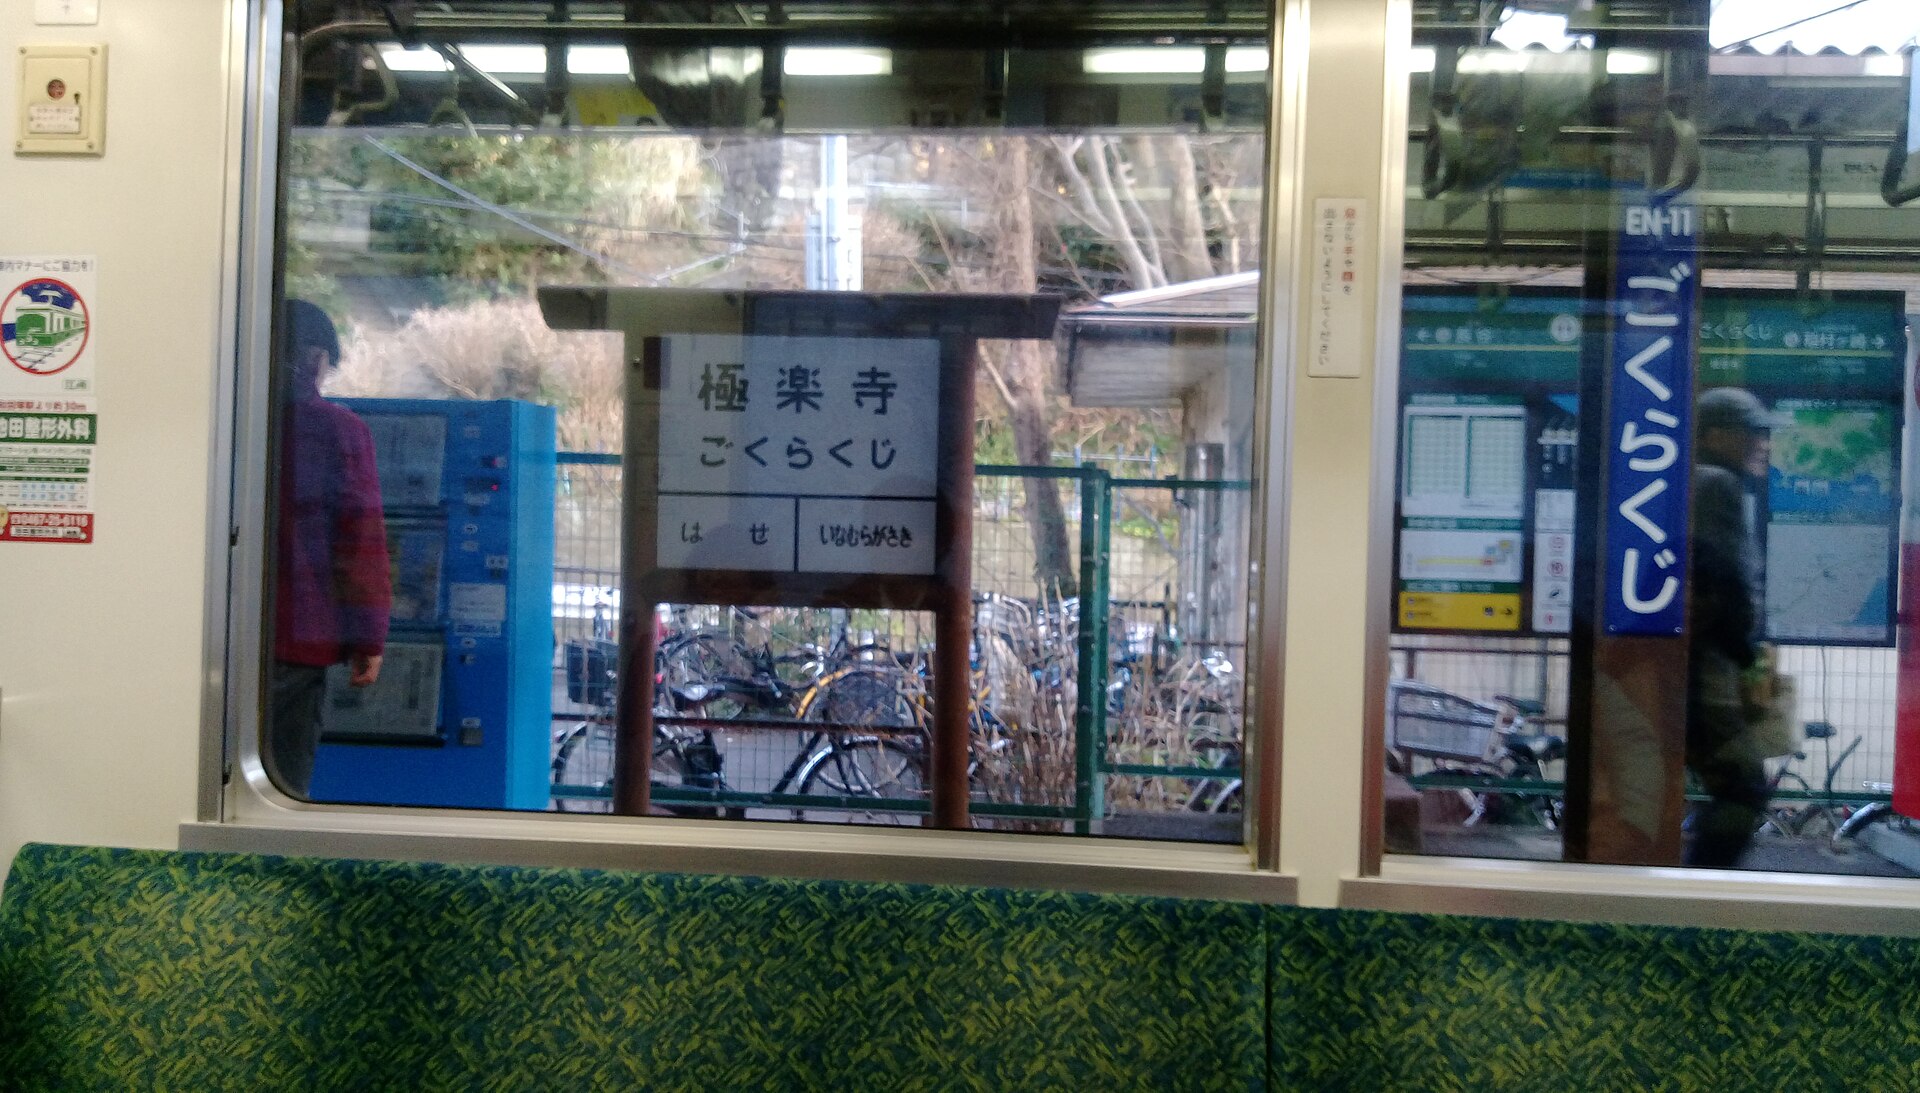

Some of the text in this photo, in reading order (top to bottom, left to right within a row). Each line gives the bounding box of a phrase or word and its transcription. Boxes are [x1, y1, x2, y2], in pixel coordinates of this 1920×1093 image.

[1626, 206, 1690, 236] EN-11
[698, 363, 897, 415] 極楽寺
[700, 436, 896, 470] ごくらくじ
[1619, 261, 1691, 614] ごくらくじ
[820, 523, 913, 548] いなむらがさき
